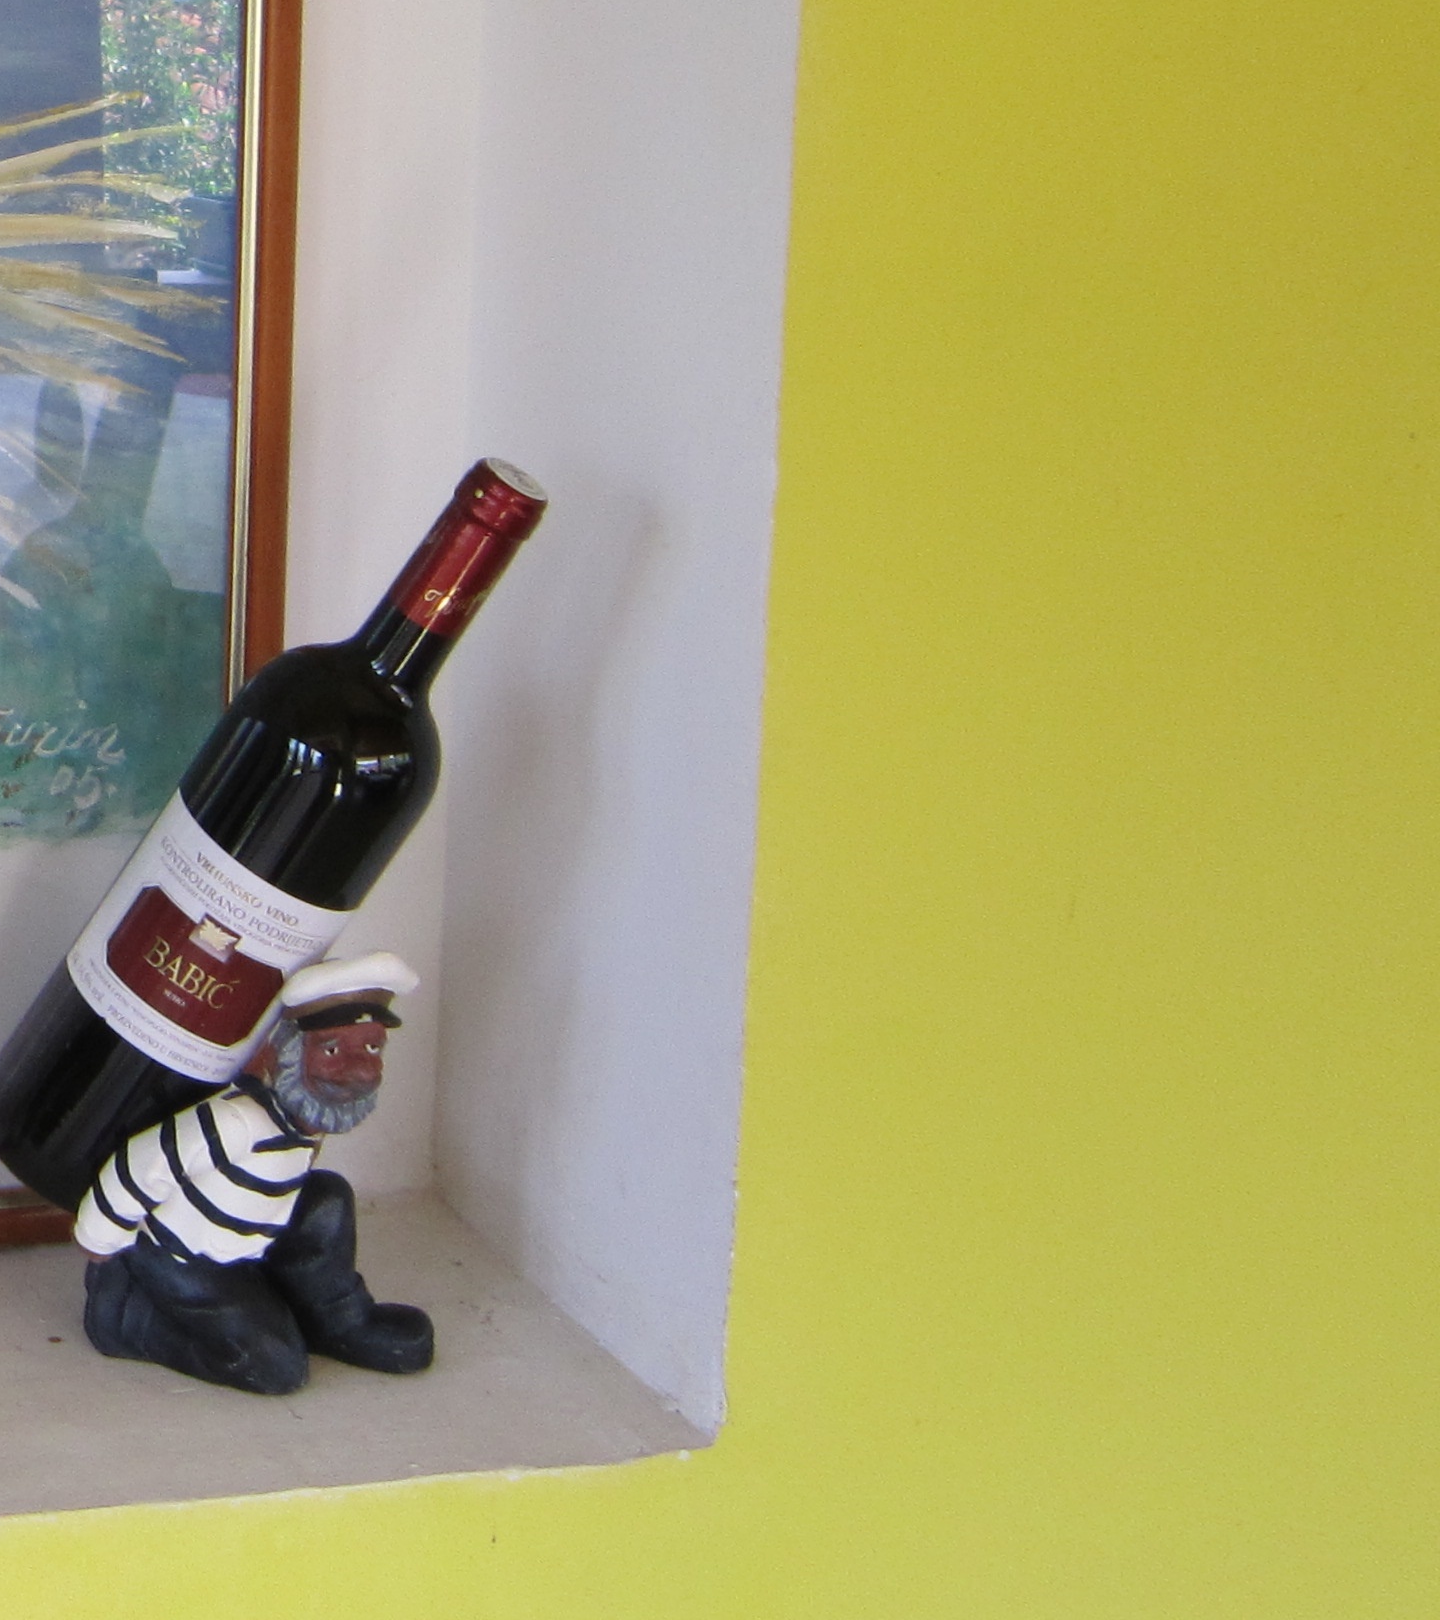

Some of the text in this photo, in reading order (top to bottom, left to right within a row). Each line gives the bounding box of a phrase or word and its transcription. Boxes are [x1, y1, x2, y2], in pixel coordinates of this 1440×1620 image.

[159, 835, 248, 921] KONTROLIRANO
[266, 904, 299, 928] VINO
[143, 936, 241, 1009] BABIĆ
